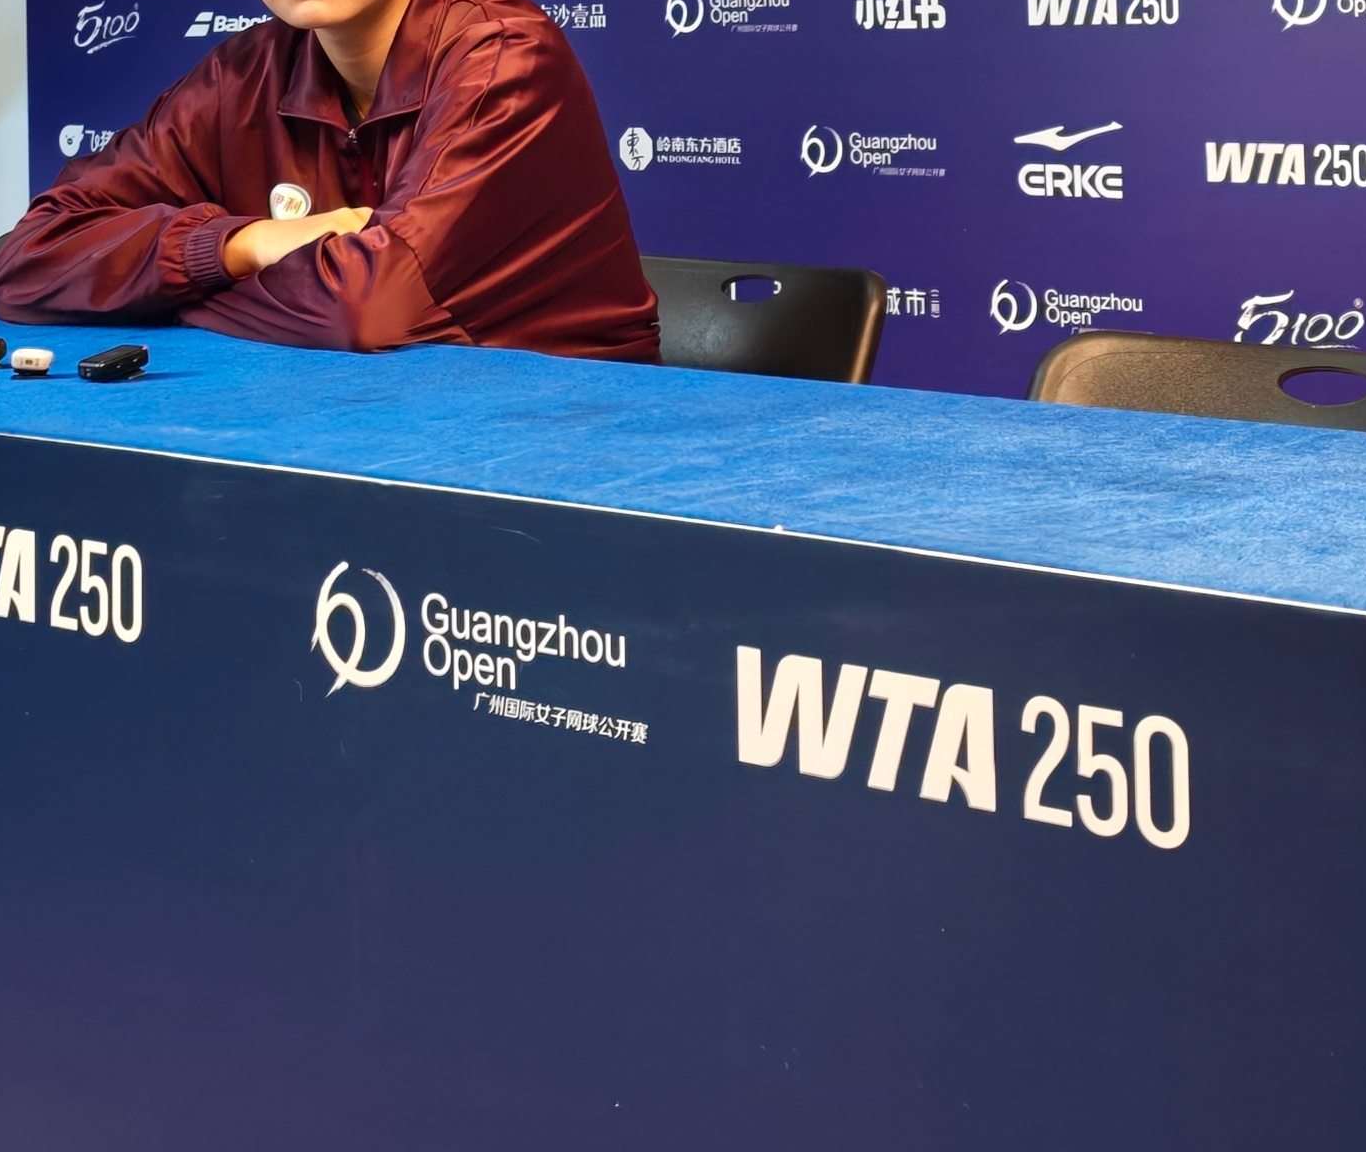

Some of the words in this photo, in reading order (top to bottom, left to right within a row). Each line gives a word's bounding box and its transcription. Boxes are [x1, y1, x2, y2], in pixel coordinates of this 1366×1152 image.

[710, 8, 749, 31] Open
[849, 133, 937, 153] Guangzhou
[850, 148, 891, 169] Open
[1017, 163, 1124, 200] ERKE
[1044, 289, 1142, 314] Guangzhou
[1045, 305, 1091, 329] Open
[49, 534, 143, 643] 250
[421, 591, 626, 670] Guangzhou
[423, 633, 516, 693] Open
[473, 691, 649, 745] 广州国际女子网球公开赛
[736, 645, 997, 813] WTA
[1021, 695, 1190, 849] 250
